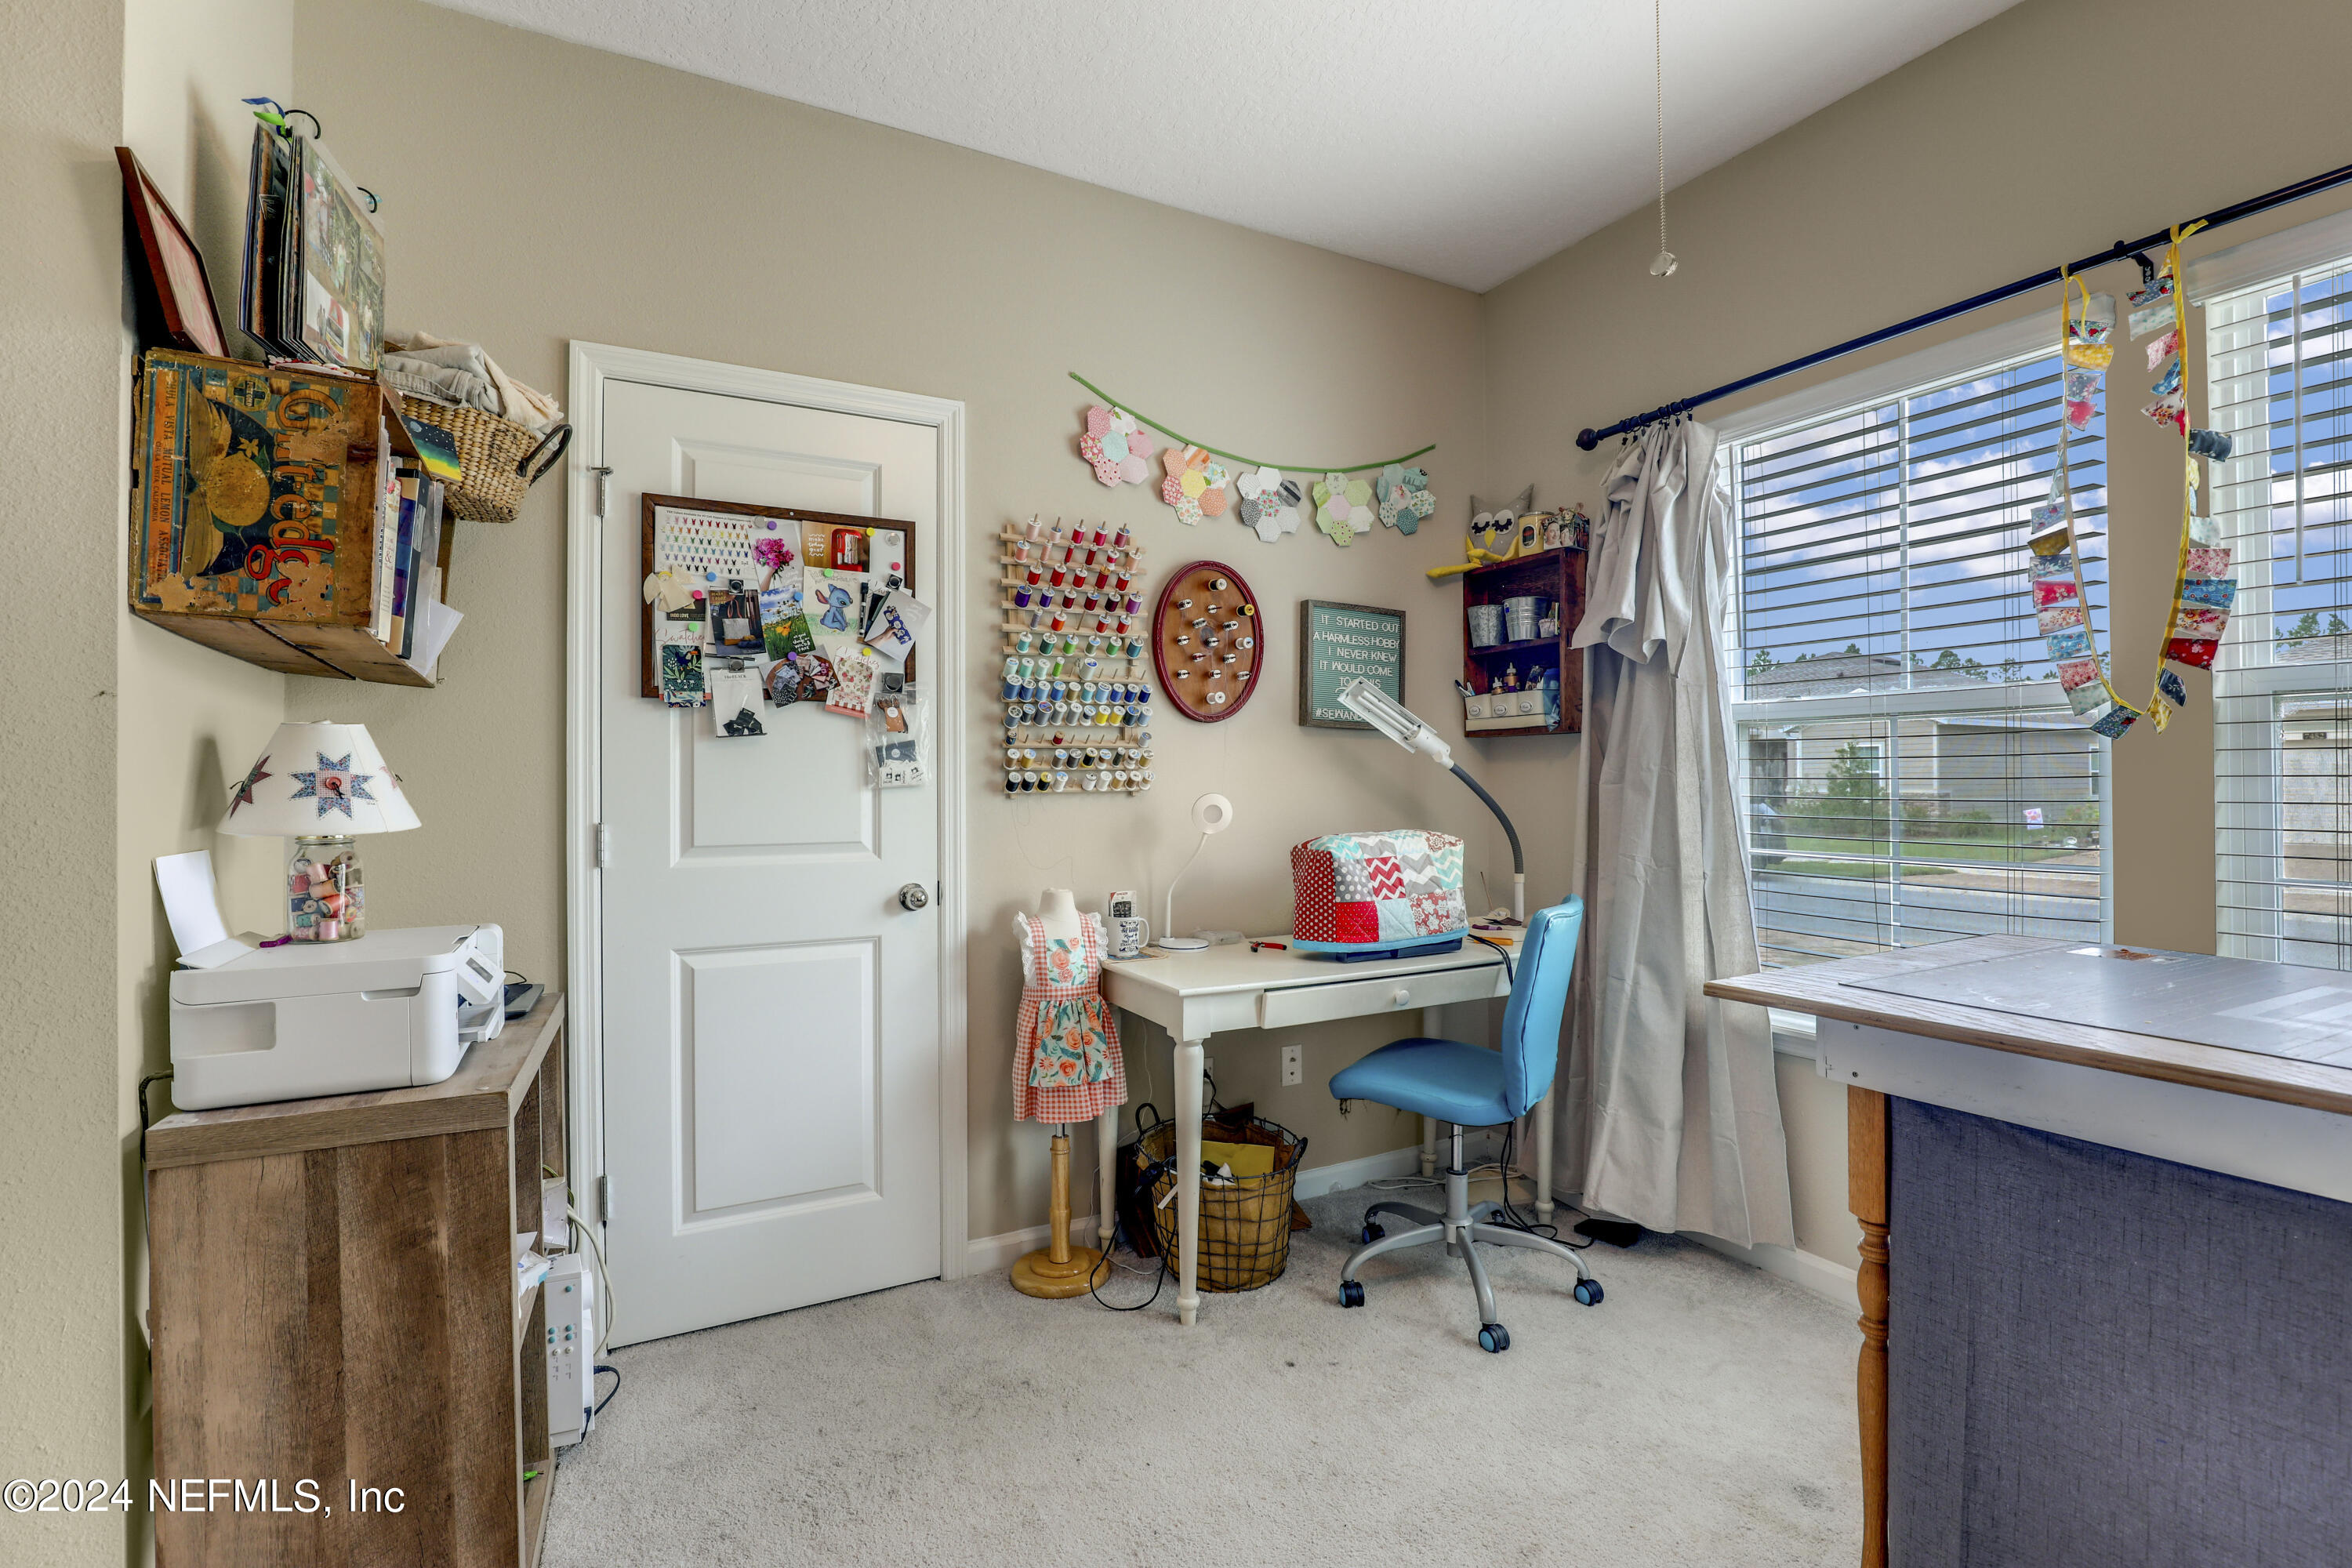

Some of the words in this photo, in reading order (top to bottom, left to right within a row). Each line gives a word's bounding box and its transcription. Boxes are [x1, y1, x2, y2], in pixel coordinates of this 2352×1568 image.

[164, 416, 176, 440] VISTA
[162, 448, 174, 485] MUTUAL
[151, 485, 160, 522] CALIFORNIA
[160, 492, 171, 523] LEMON
[1321, 615, 1330, 624] IT
[1336, 616, 1379, 630] STARTED
[1382, 622, 1400, 633] OUT
[1313, 631, 1320, 640] A
[1323, 631, 1370, 646] HARMLESS
[1372, 637, 1400, 649] HOBBY
[1337, 647, 1368, 660] NEVER
[1371, 652, 1397, 662] KNEW
[1319, 659, 1328, 670] IT
[1332, 661, 1365, 673] WOULD
[1367, 665, 1393, 677] COME
[1338, 677, 1351, 687] TO
